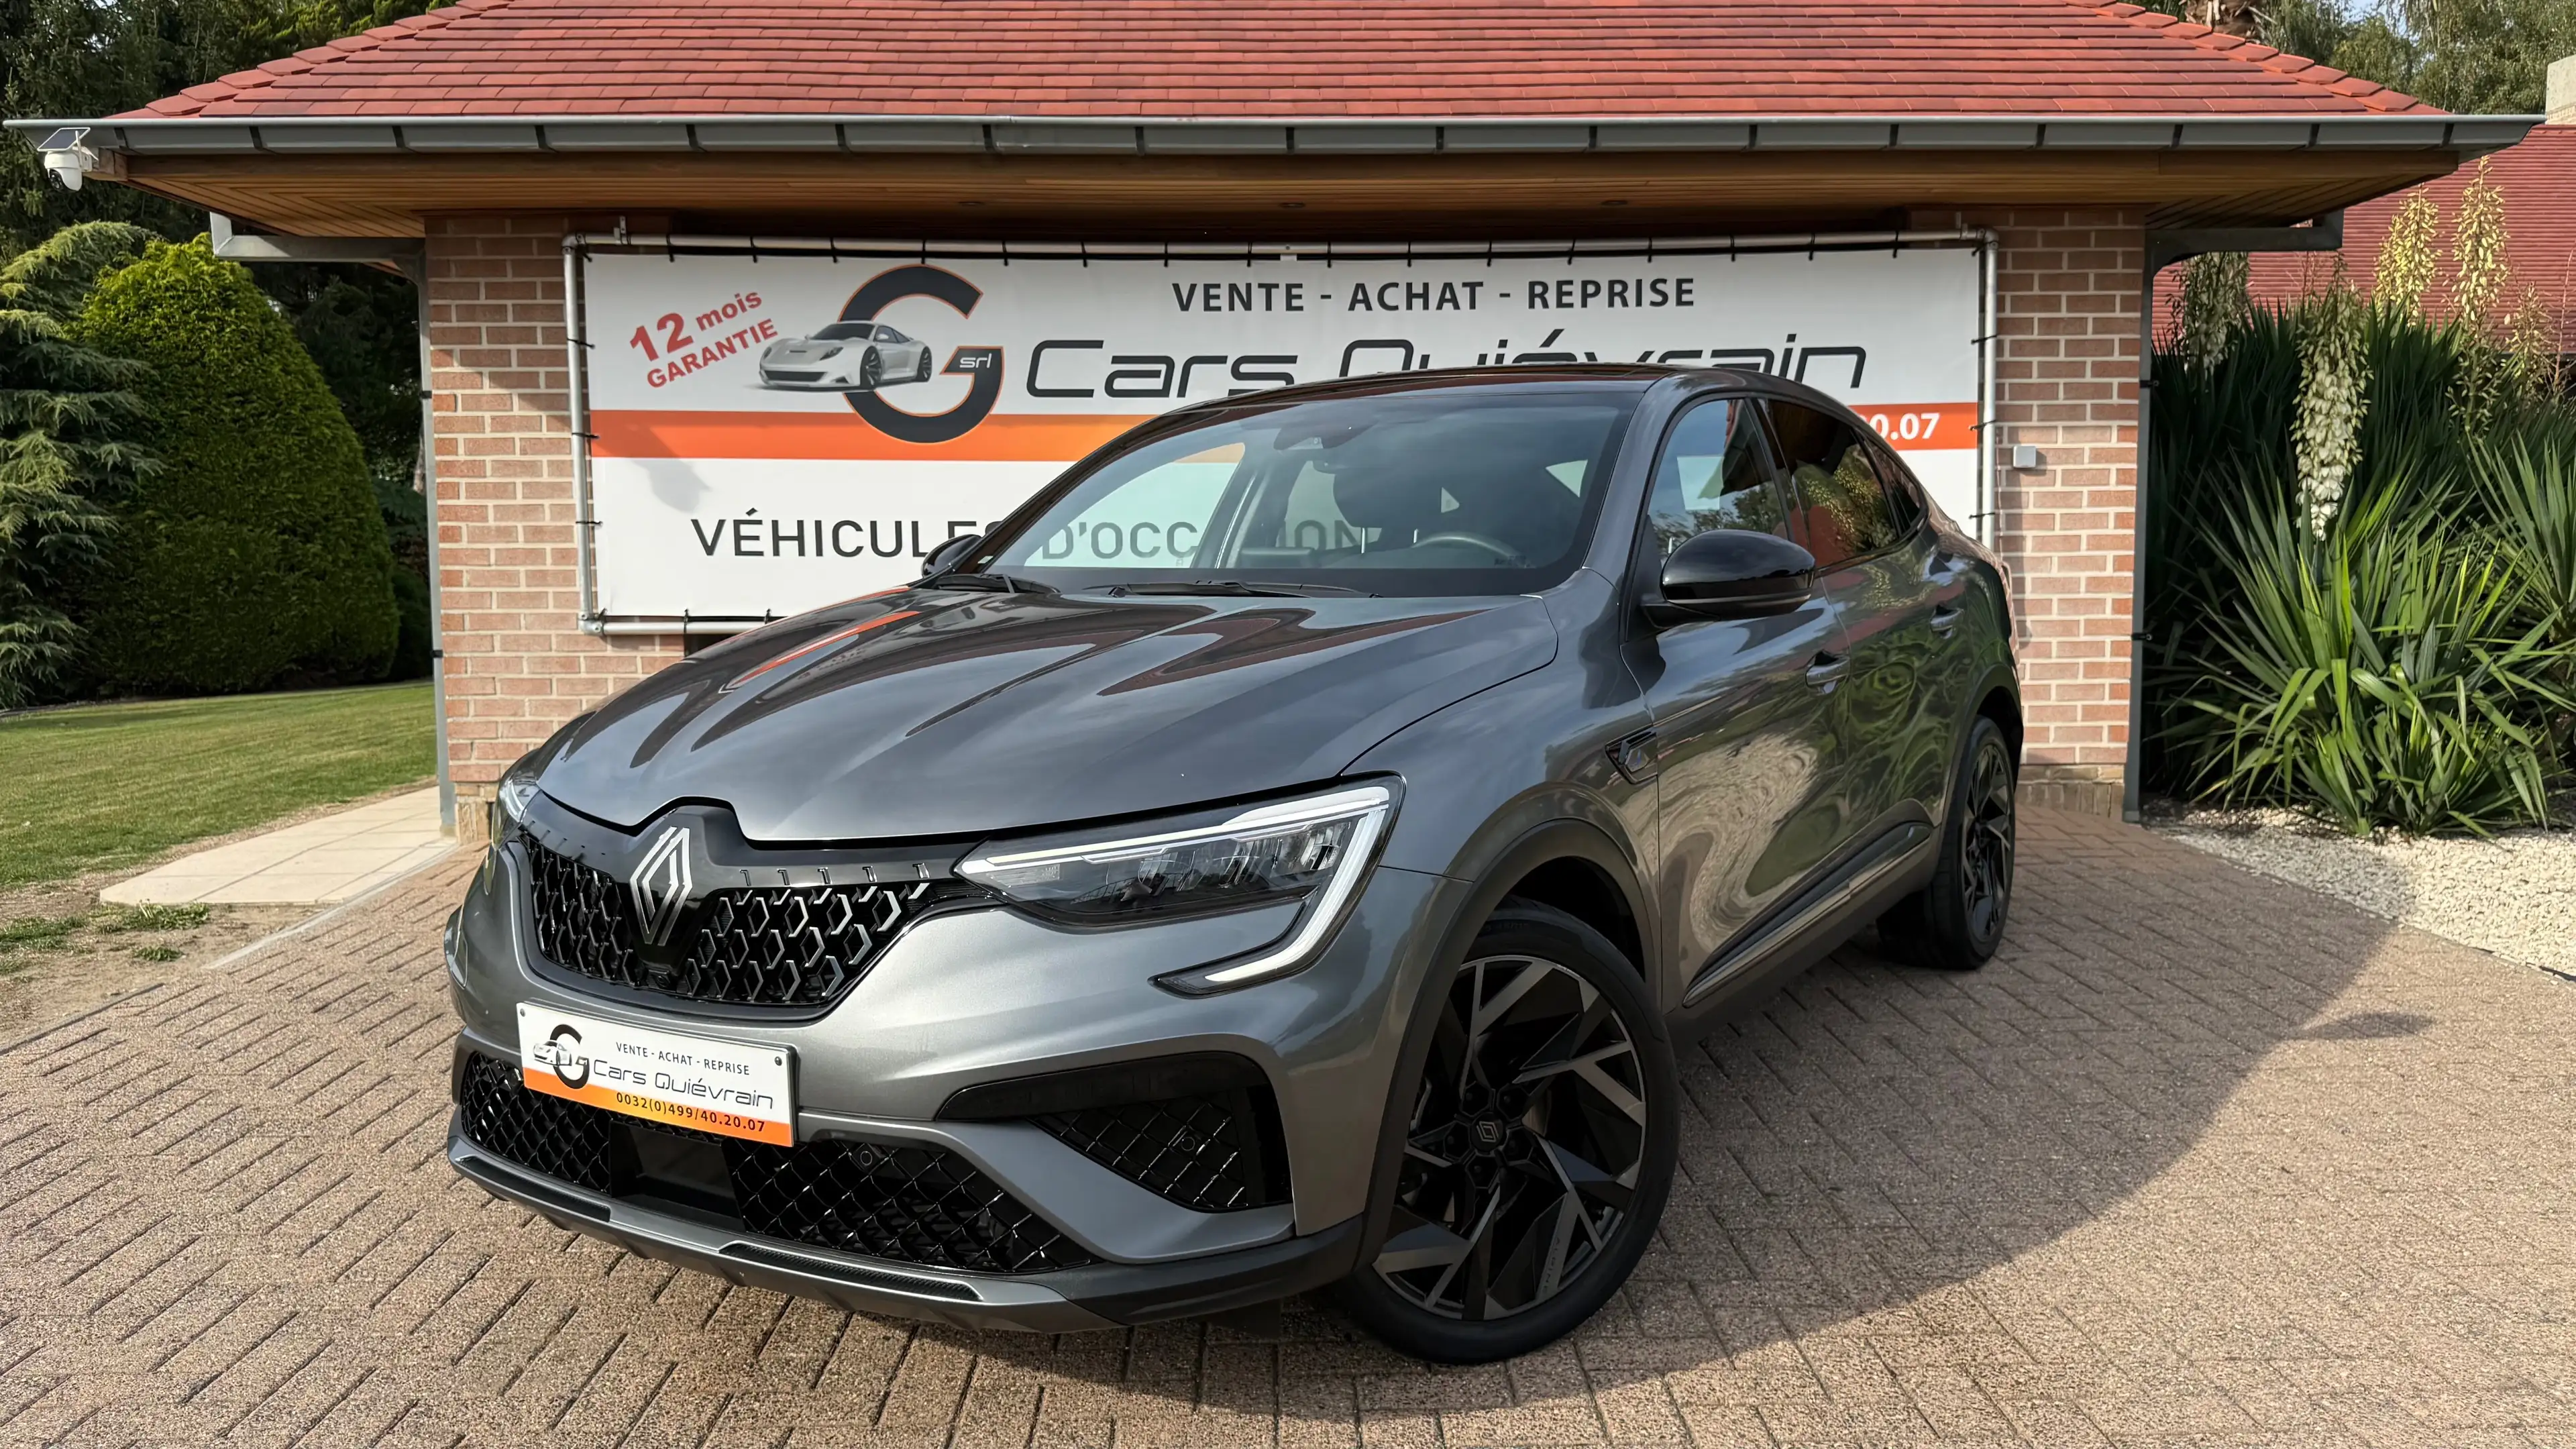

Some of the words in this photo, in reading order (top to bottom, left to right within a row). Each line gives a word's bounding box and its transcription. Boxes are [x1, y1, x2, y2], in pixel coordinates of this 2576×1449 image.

[1171, 282, 1304, 312] VENTE
[1348, 281, 1484, 311] ACHAT
[1528, 278, 1694, 309] REPRISE
[631, 313, 693, 361] 12
[696, 292, 762, 331] mois
[647, 319, 777, 388] GARANTIE
[959, 353, 992, 368] srl
[1026, 339, 1298, 398] Cars
[616, 1042, 648, 1057] VENTE
[658, 1051, 692, 1066] ACHAT
[704, 1059, 750, 1075] REPRISE
[594, 1059, 647, 1085] Cars
[655, 1072, 773, 1110] Quiévrain
[616, 1092, 765, 1132] 0032(0)499/40.20.07
